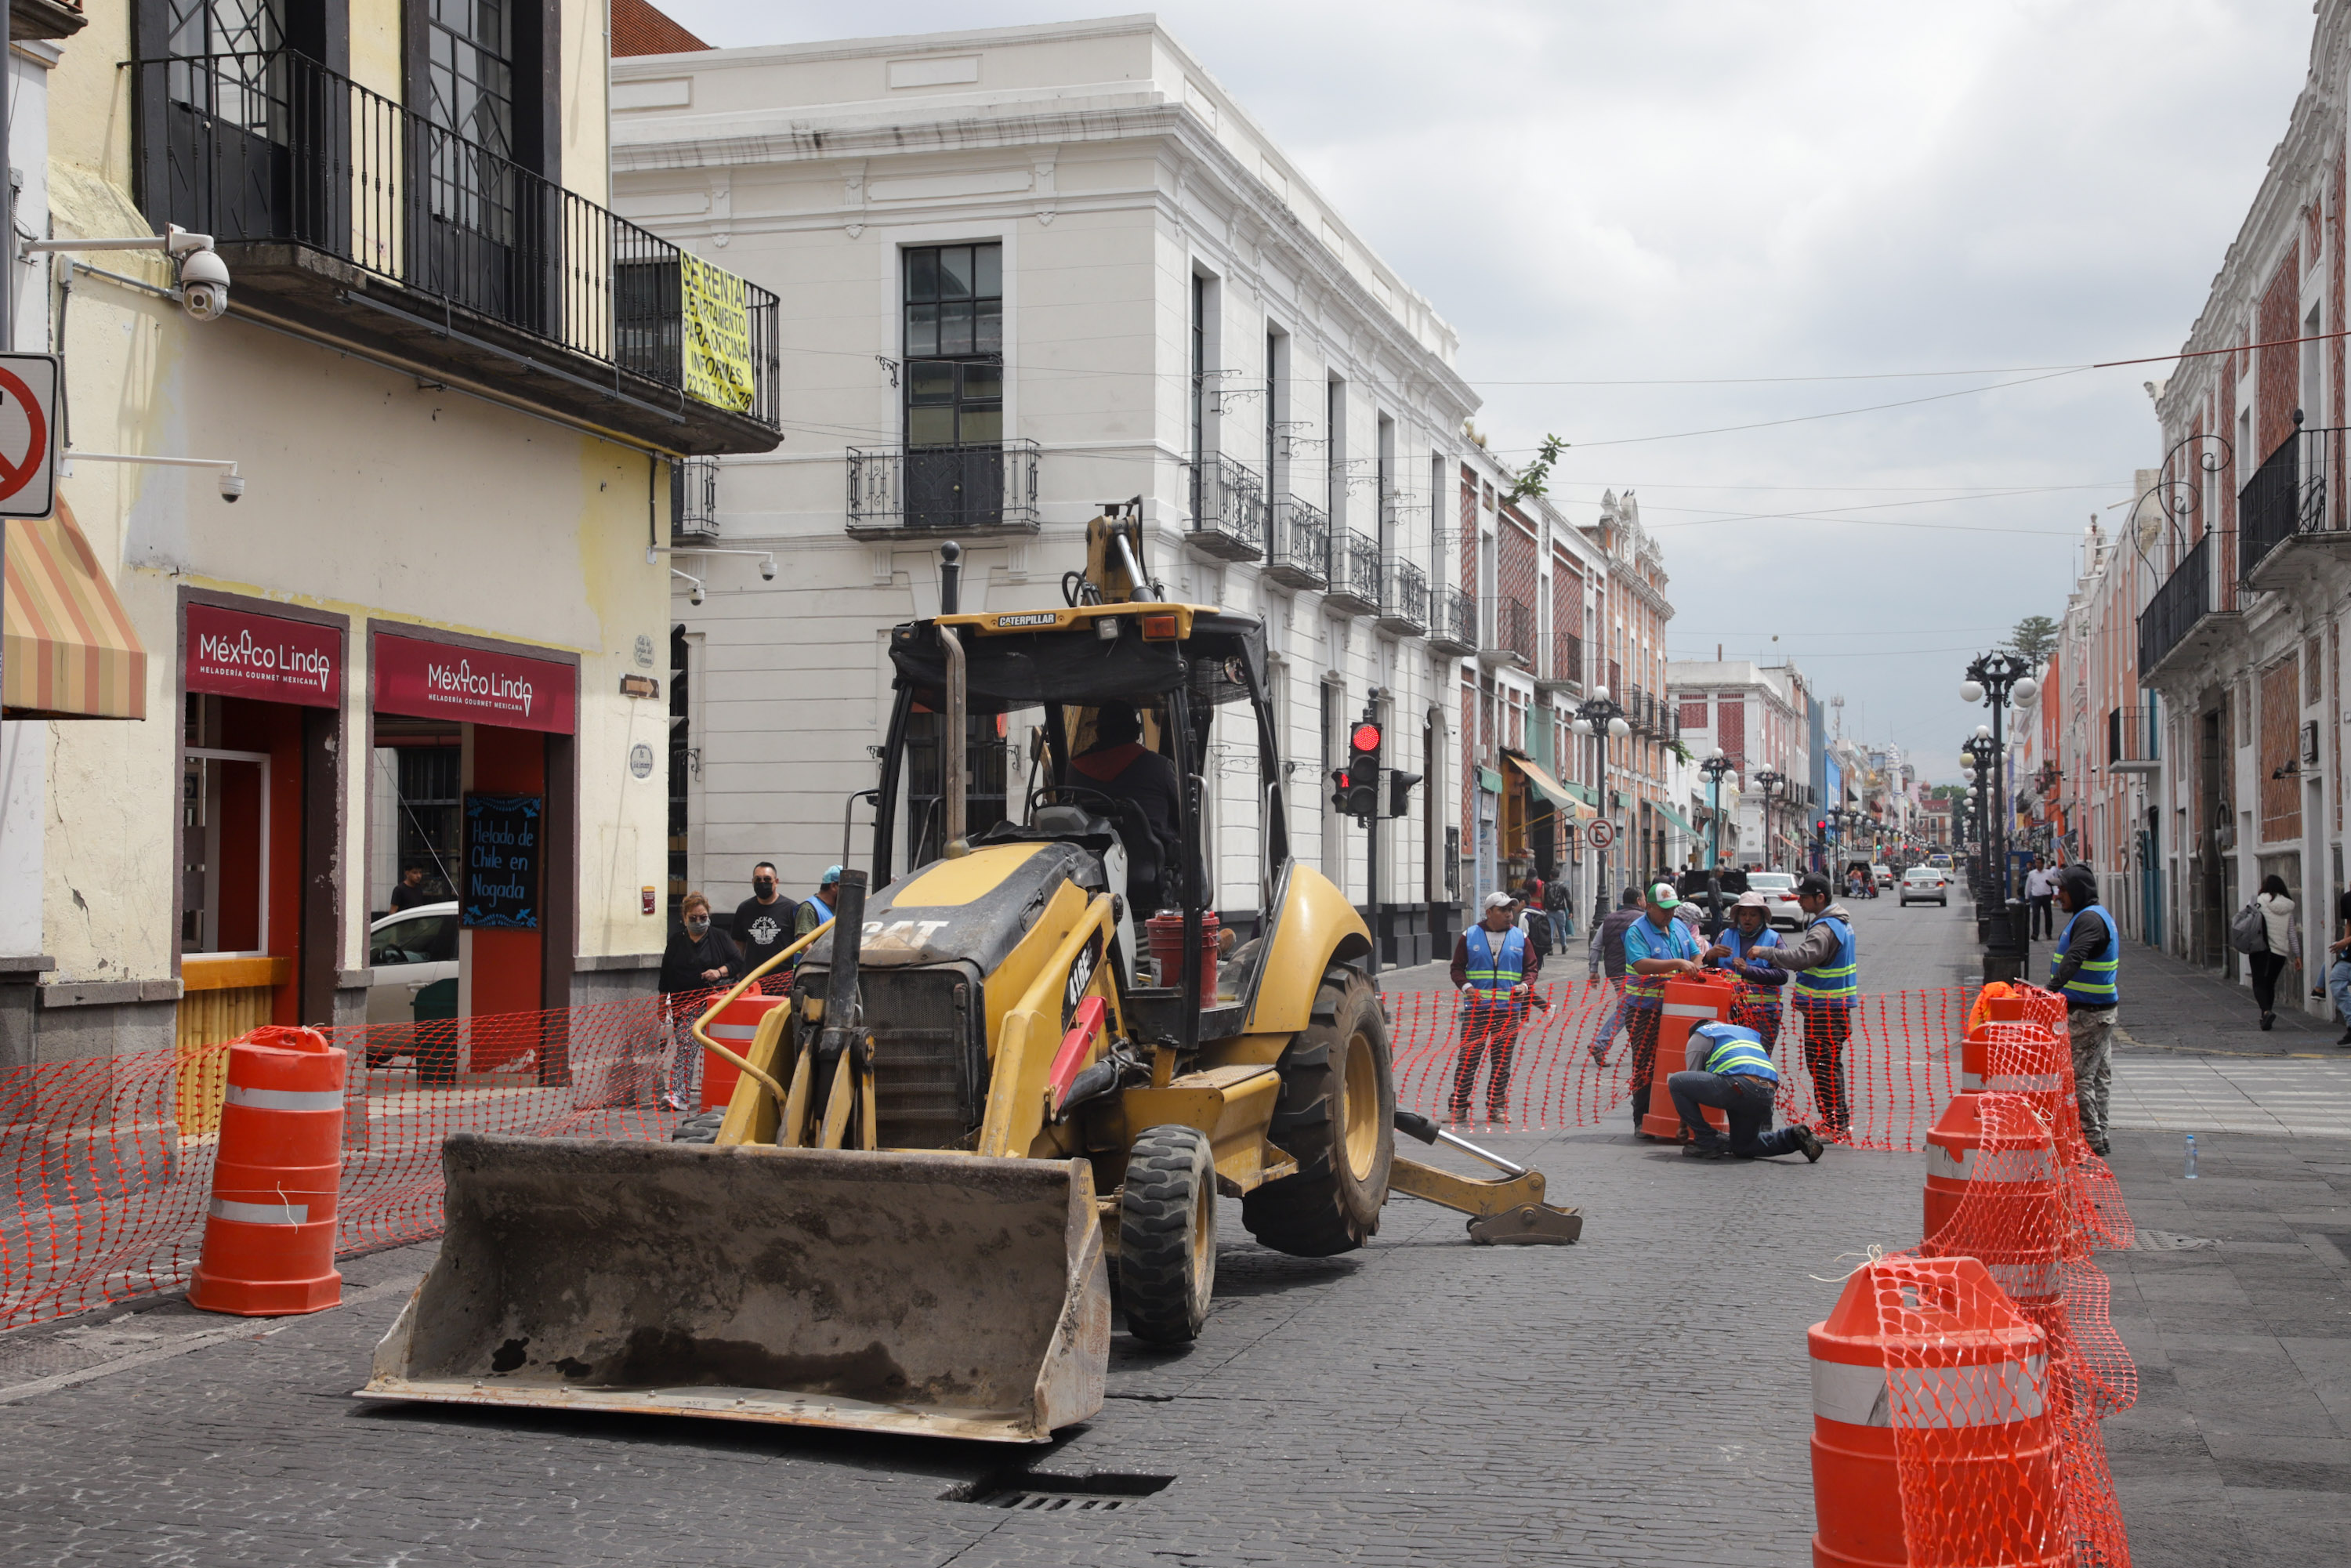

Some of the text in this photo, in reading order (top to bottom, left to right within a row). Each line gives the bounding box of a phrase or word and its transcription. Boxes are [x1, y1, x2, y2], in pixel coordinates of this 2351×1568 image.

[683, 252, 745, 311] SE RENTA
[684, 290, 746, 337] DEPARTAMENTO
[684, 317, 750, 364] PARA OFICINA
[690, 350, 744, 387] INFORMES
[999, 614, 1054, 626] CATERPILLAR
[200, 629, 330, 693] México Lindo
[200, 666, 318, 686] HELADERÍA GOURMET MEXICANA
[428, 658, 533, 718] México Lindo
[428, 693, 523, 712] HELADERÍA GOURMET MEXICANA
[473, 820, 534, 847] Helado de
[472, 846, 529, 871] Chile en
[472, 872, 525, 908] Nogada
[752, 916, 777, 929] DOCKERS
[860, 920, 950, 951] CAT
[1069, 948, 1091, 1006] 416E
